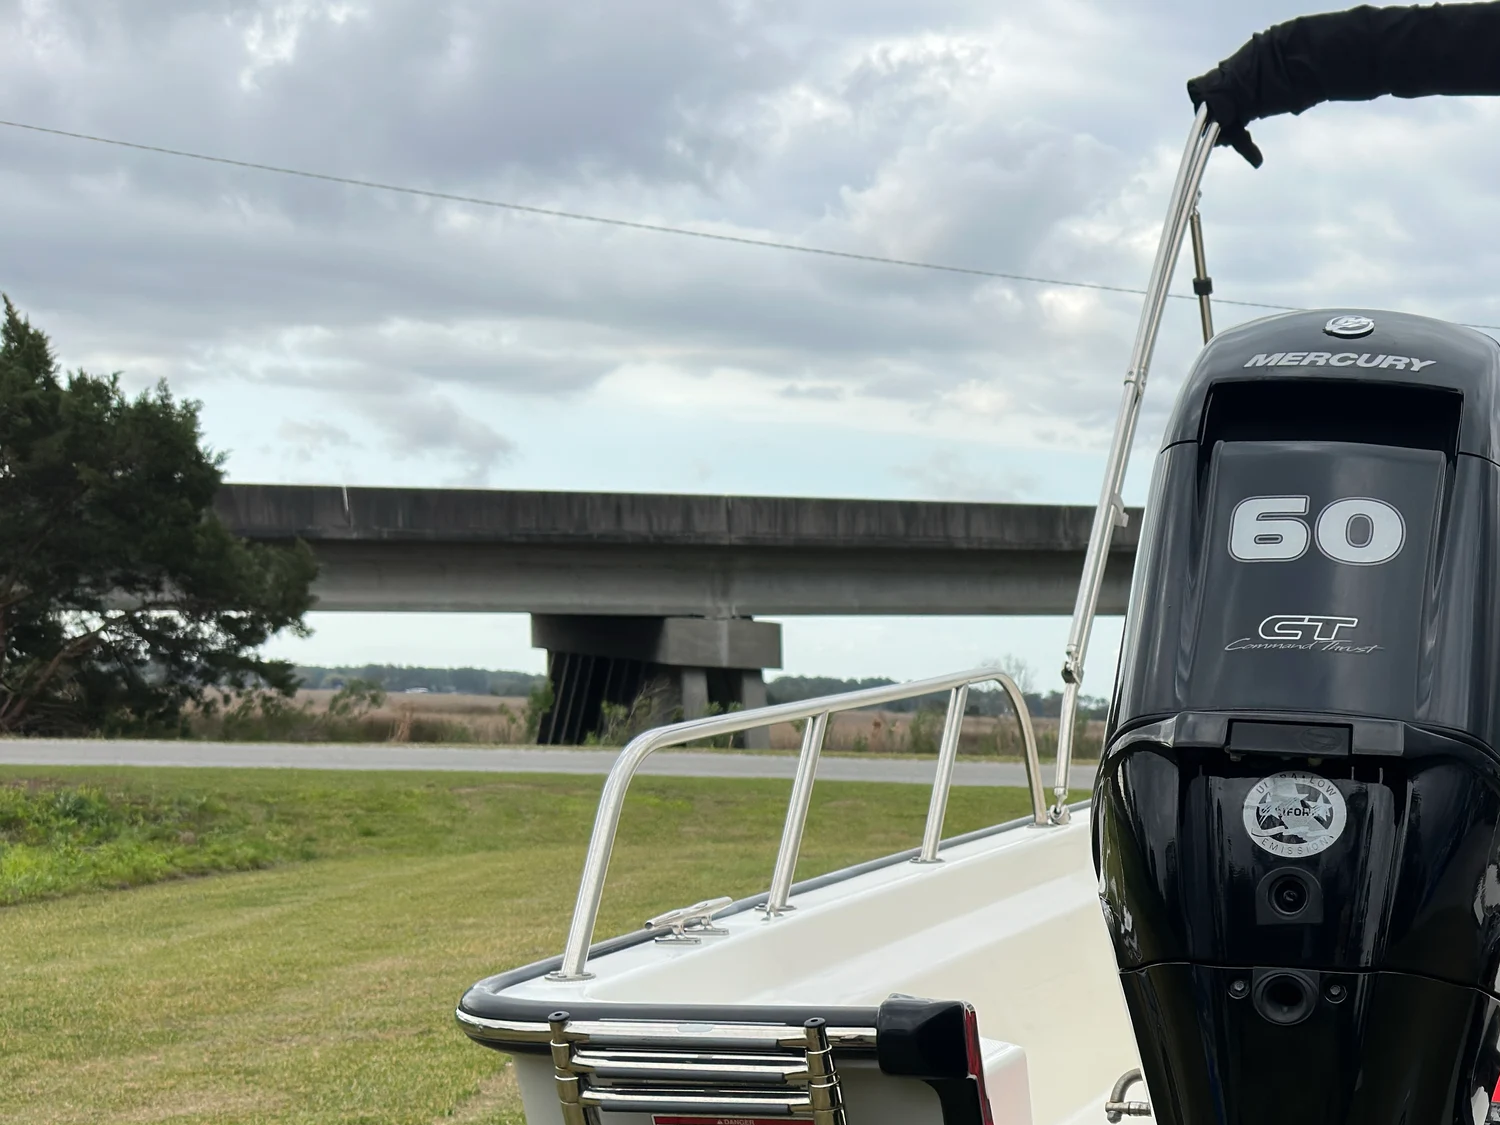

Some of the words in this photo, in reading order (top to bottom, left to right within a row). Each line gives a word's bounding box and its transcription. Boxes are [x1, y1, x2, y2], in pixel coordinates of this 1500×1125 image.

[1243, 351, 1437, 373] MERCURY
[1227, 494, 1407, 567] 60
[1224, 637, 1318, 652] Command
[1317, 640, 1384, 654] Thrust
[1261, 836, 1329, 855] EMISSION
